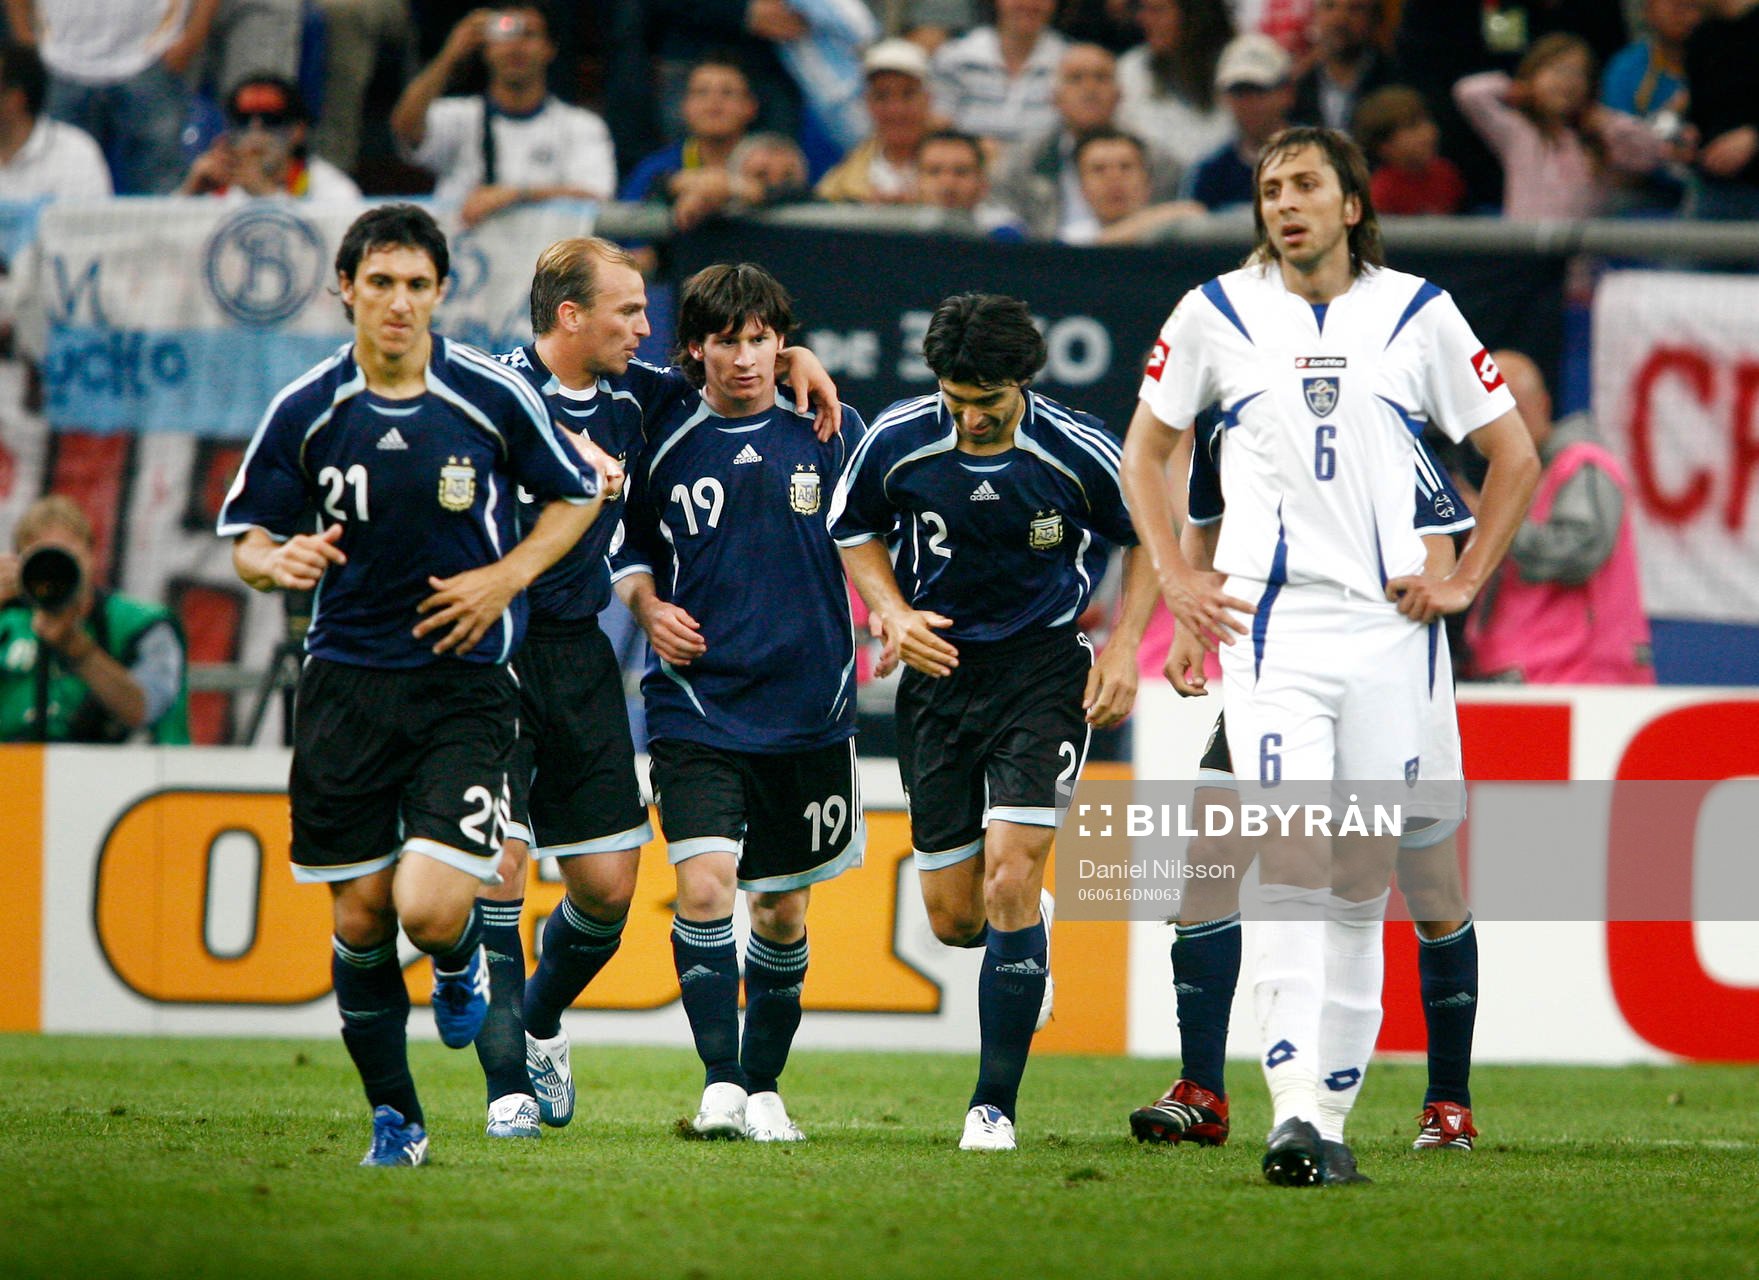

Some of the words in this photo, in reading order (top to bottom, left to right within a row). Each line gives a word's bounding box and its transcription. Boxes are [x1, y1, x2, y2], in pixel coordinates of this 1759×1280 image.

[1314, 424, 1337, 482] 6
[317, 463, 370, 522] 21
[670, 476, 725, 536] 19
[969, 493, 1001, 502] adidas
[920, 510, 952, 559] 2
[1055, 740, 1077, 798] 2
[1259, 732, 1283, 789] 6
[803, 794, 848, 853] 19
